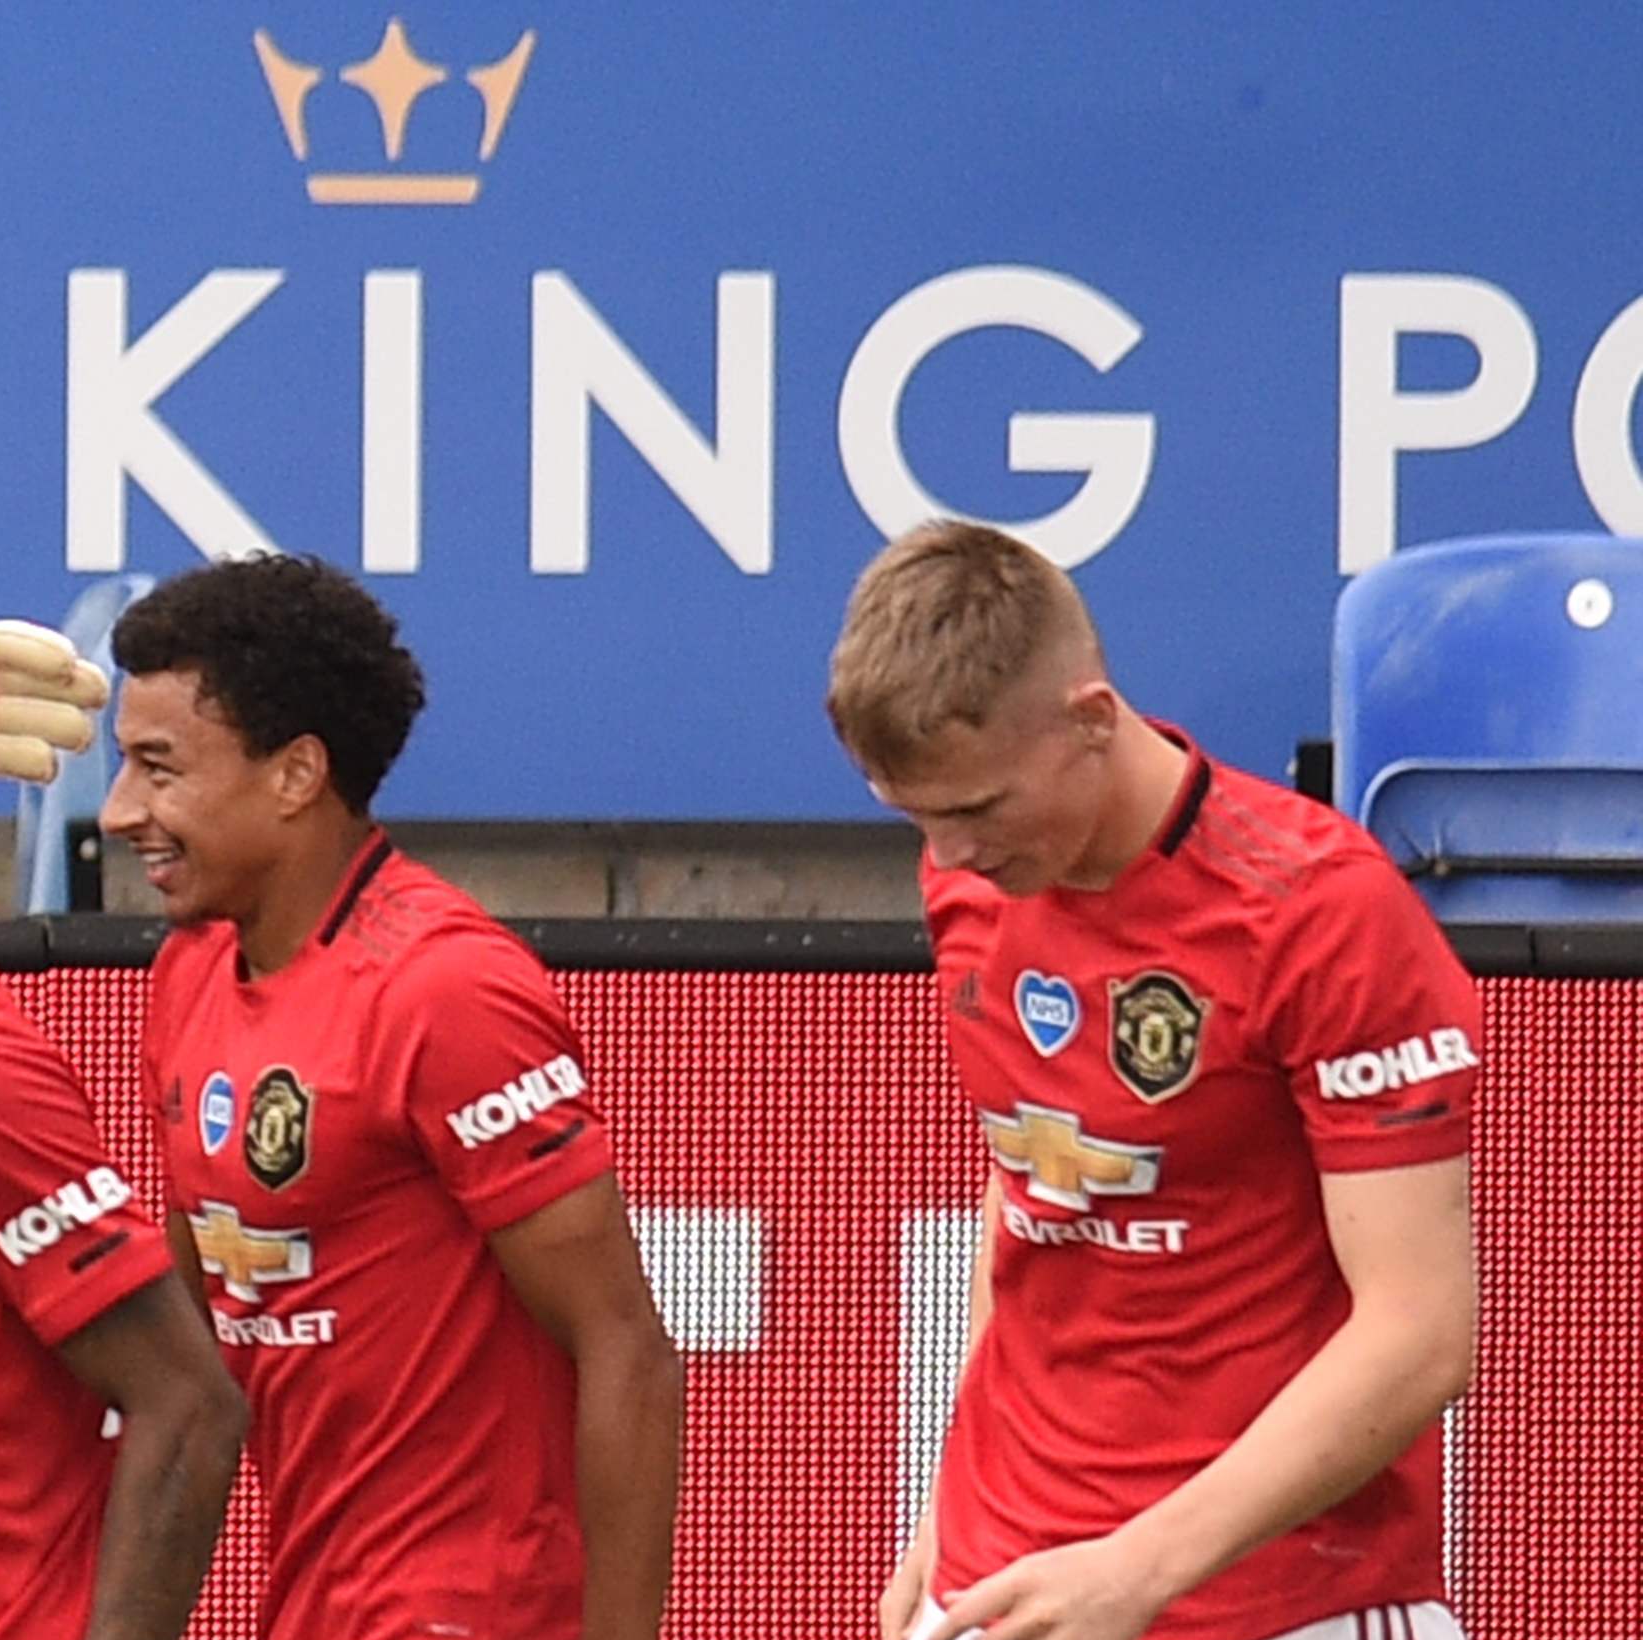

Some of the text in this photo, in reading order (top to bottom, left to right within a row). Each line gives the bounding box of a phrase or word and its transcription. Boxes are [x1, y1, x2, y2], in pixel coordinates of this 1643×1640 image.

[66, 266, 1155, 575] KING
[1028, 996, 1065, 1022] NHS
[1315, 1027, 1482, 1099] KOHLER
